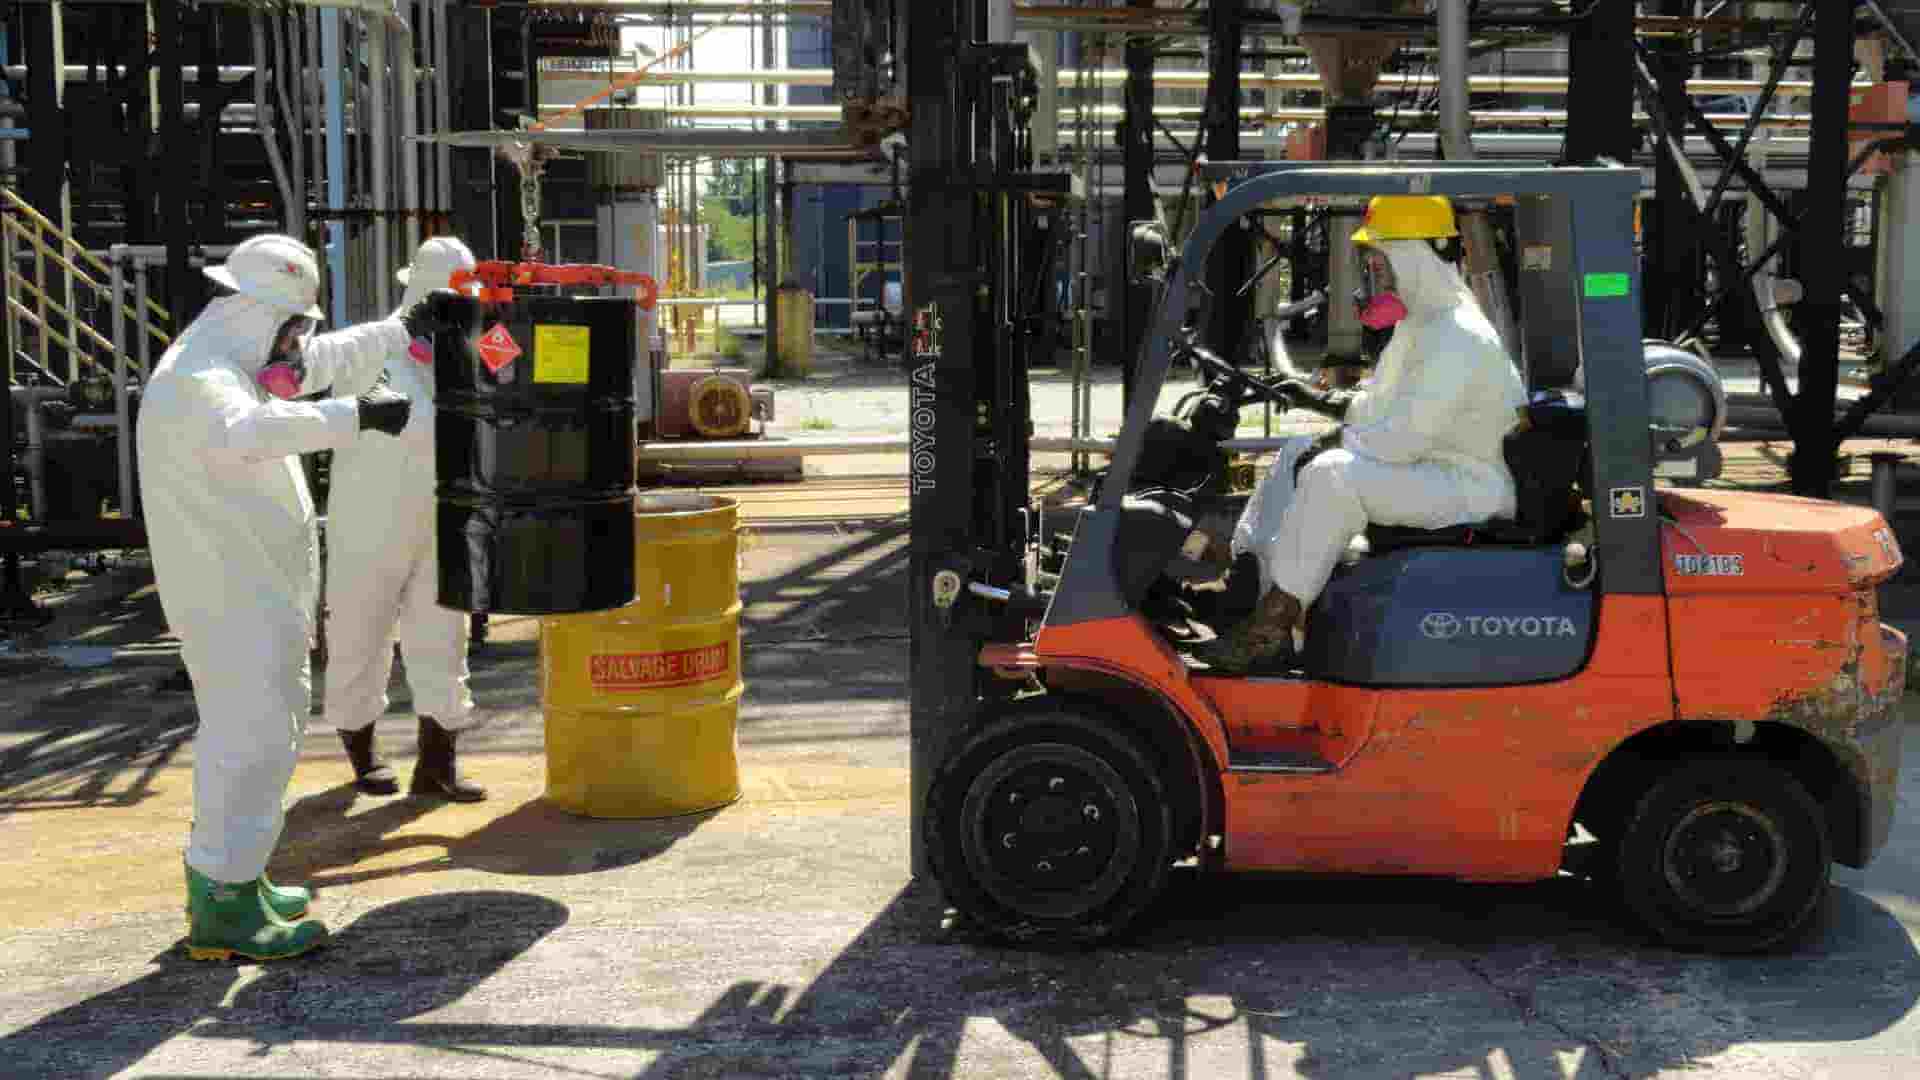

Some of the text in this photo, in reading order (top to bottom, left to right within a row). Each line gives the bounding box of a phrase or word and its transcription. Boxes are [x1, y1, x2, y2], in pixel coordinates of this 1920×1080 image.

[912, 363, 936, 495] TOYOTA
[1465, 616, 1576, 637] TOYOTA
[592, 654, 678, 681] SALVAGE
